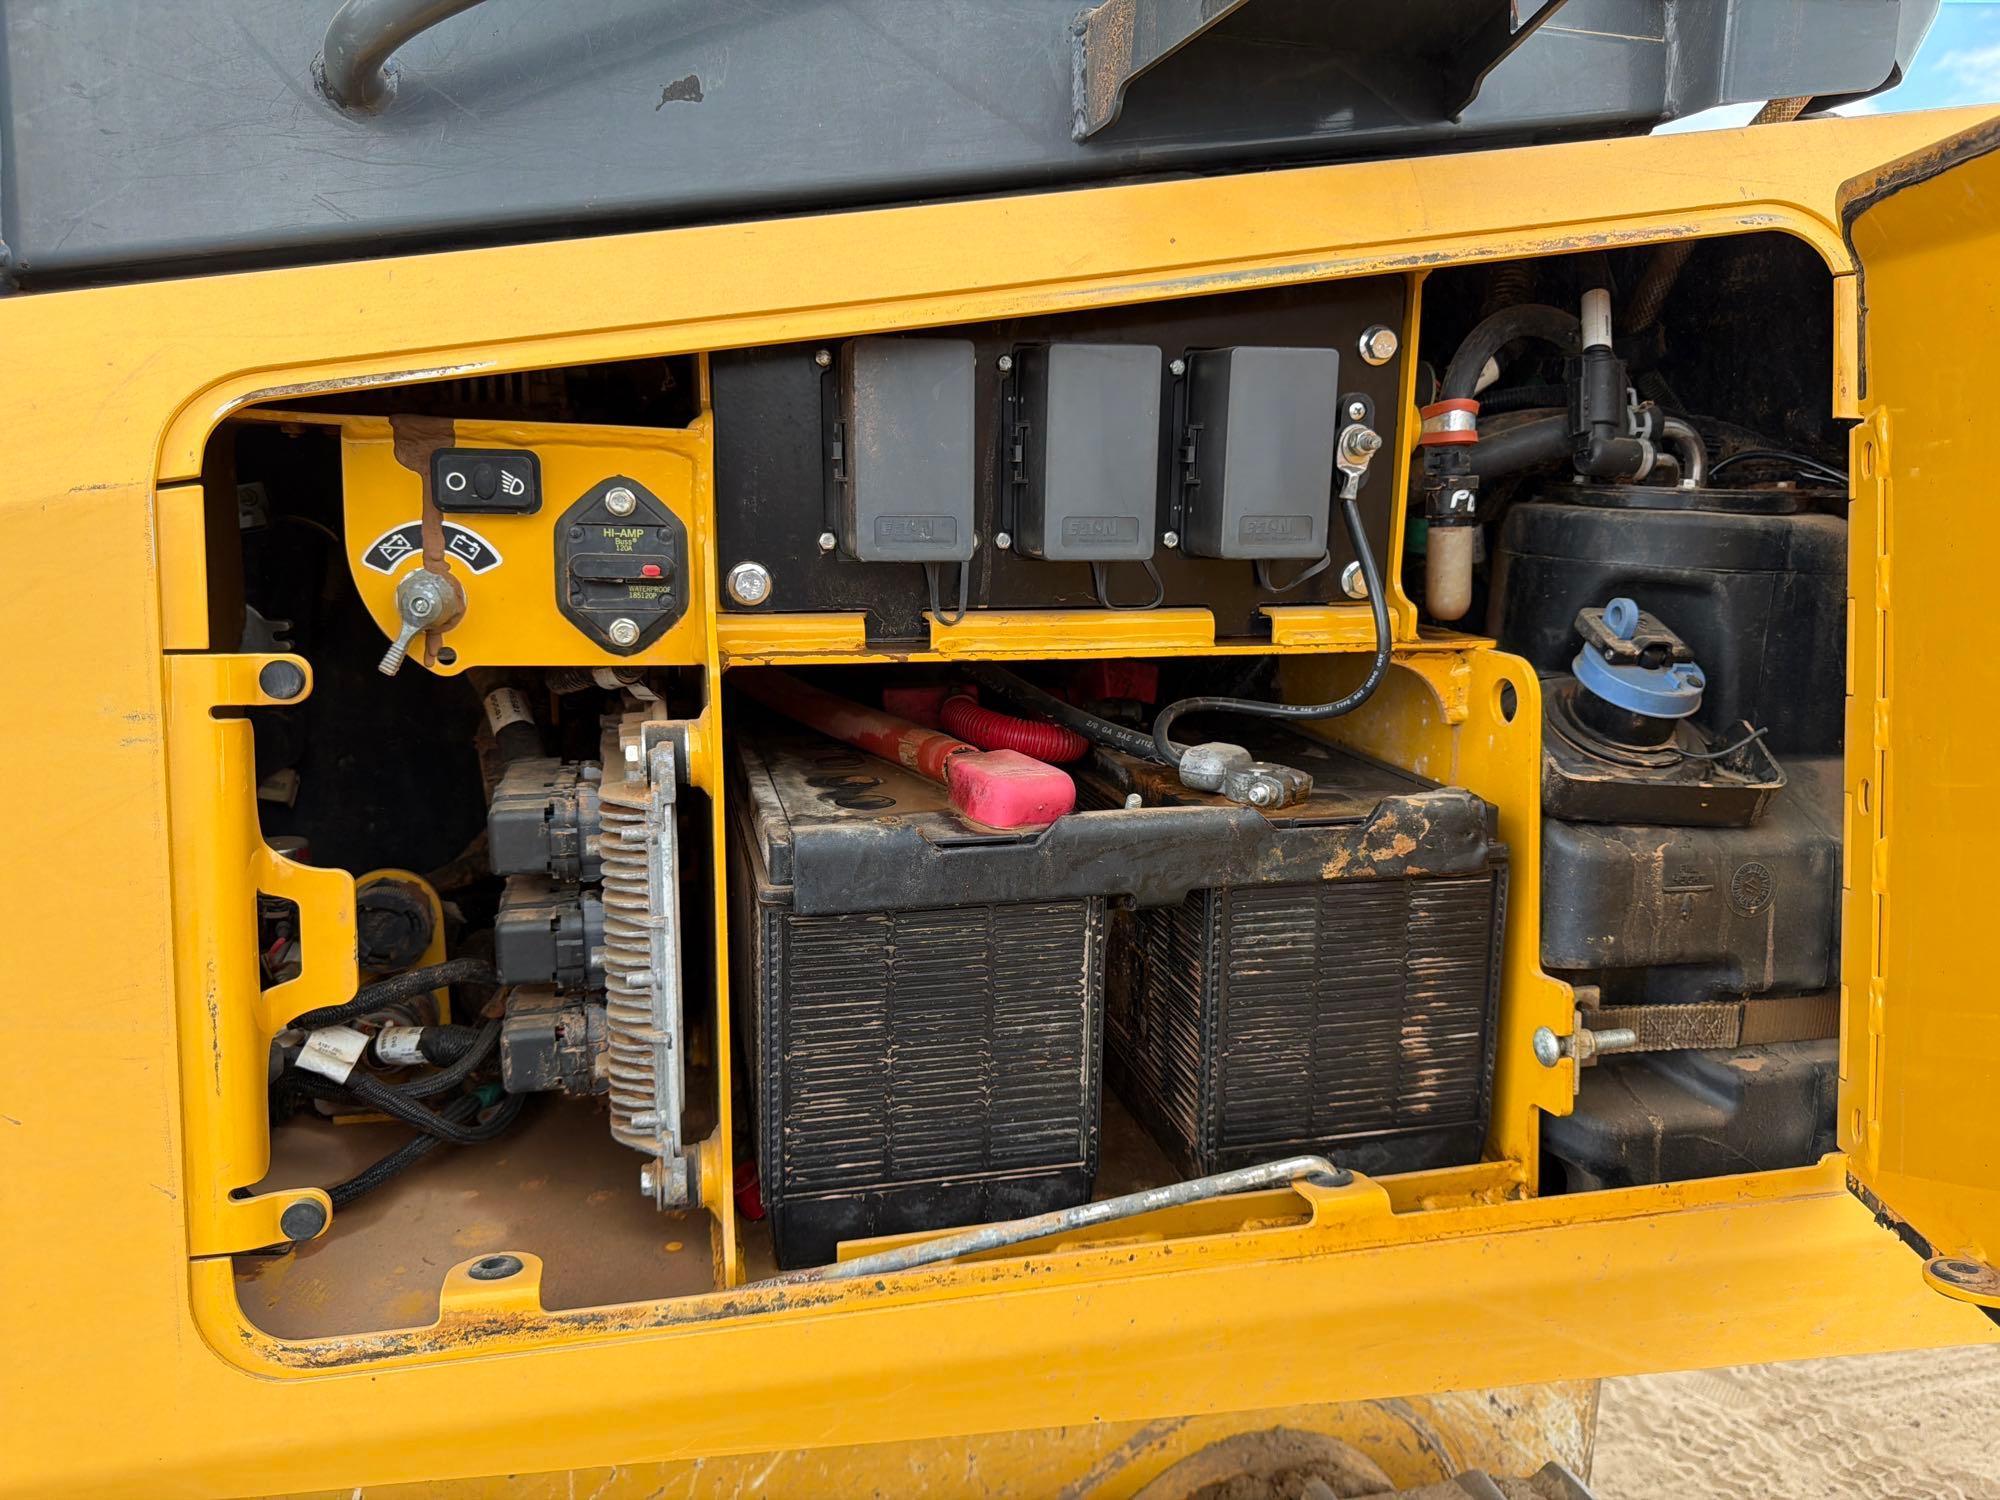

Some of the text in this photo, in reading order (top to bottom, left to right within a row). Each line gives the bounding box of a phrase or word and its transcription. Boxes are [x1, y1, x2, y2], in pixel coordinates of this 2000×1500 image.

[603, 528, 644, 538] HI-AMP
[628, 585, 671, 593] WATERPROOF
[1336, 699, 1351, 709] TYPE
[1085, 720, 1099, 730] 2/0
[1102, 726, 1113, 735] GA
[1116, 731, 1133, 742] SAE
